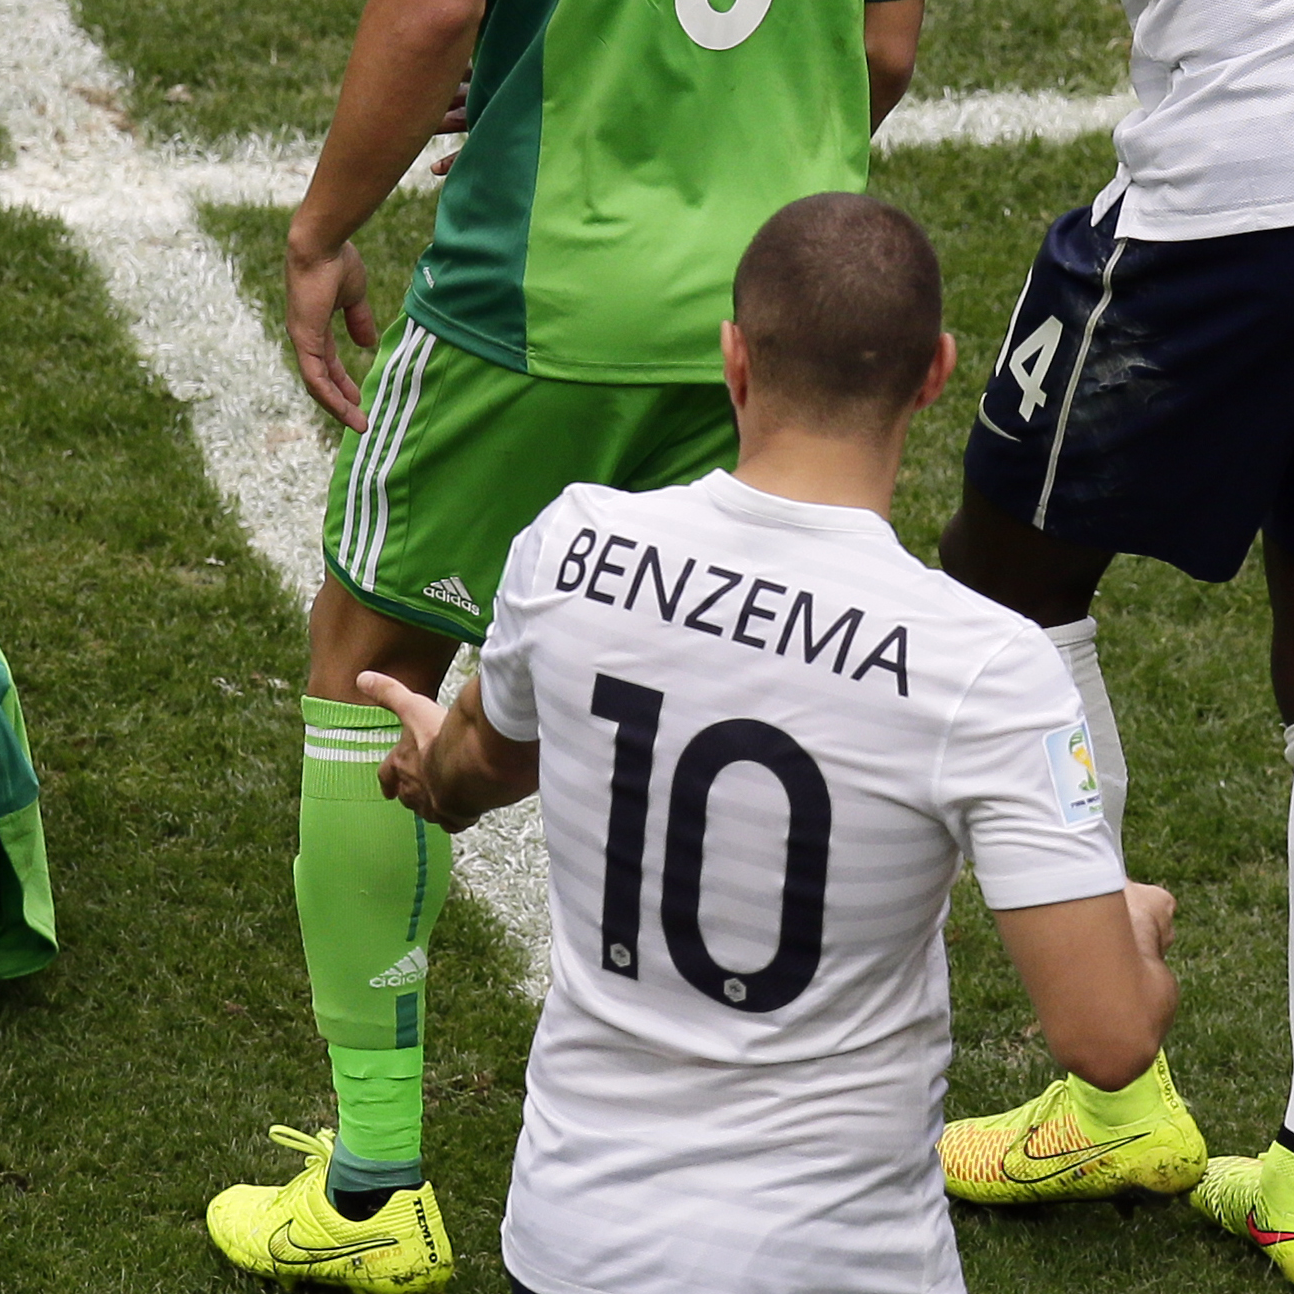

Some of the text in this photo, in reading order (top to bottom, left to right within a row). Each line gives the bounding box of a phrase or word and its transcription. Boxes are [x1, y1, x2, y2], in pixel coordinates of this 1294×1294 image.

[422, 586, 480, 616] adidas
[555, 527, 910, 698] BENZEMA
[590, 672, 832, 1013] 10
[369, 966, 428, 987] adida
[413, 1197, 438, 1264] TIEMPO
